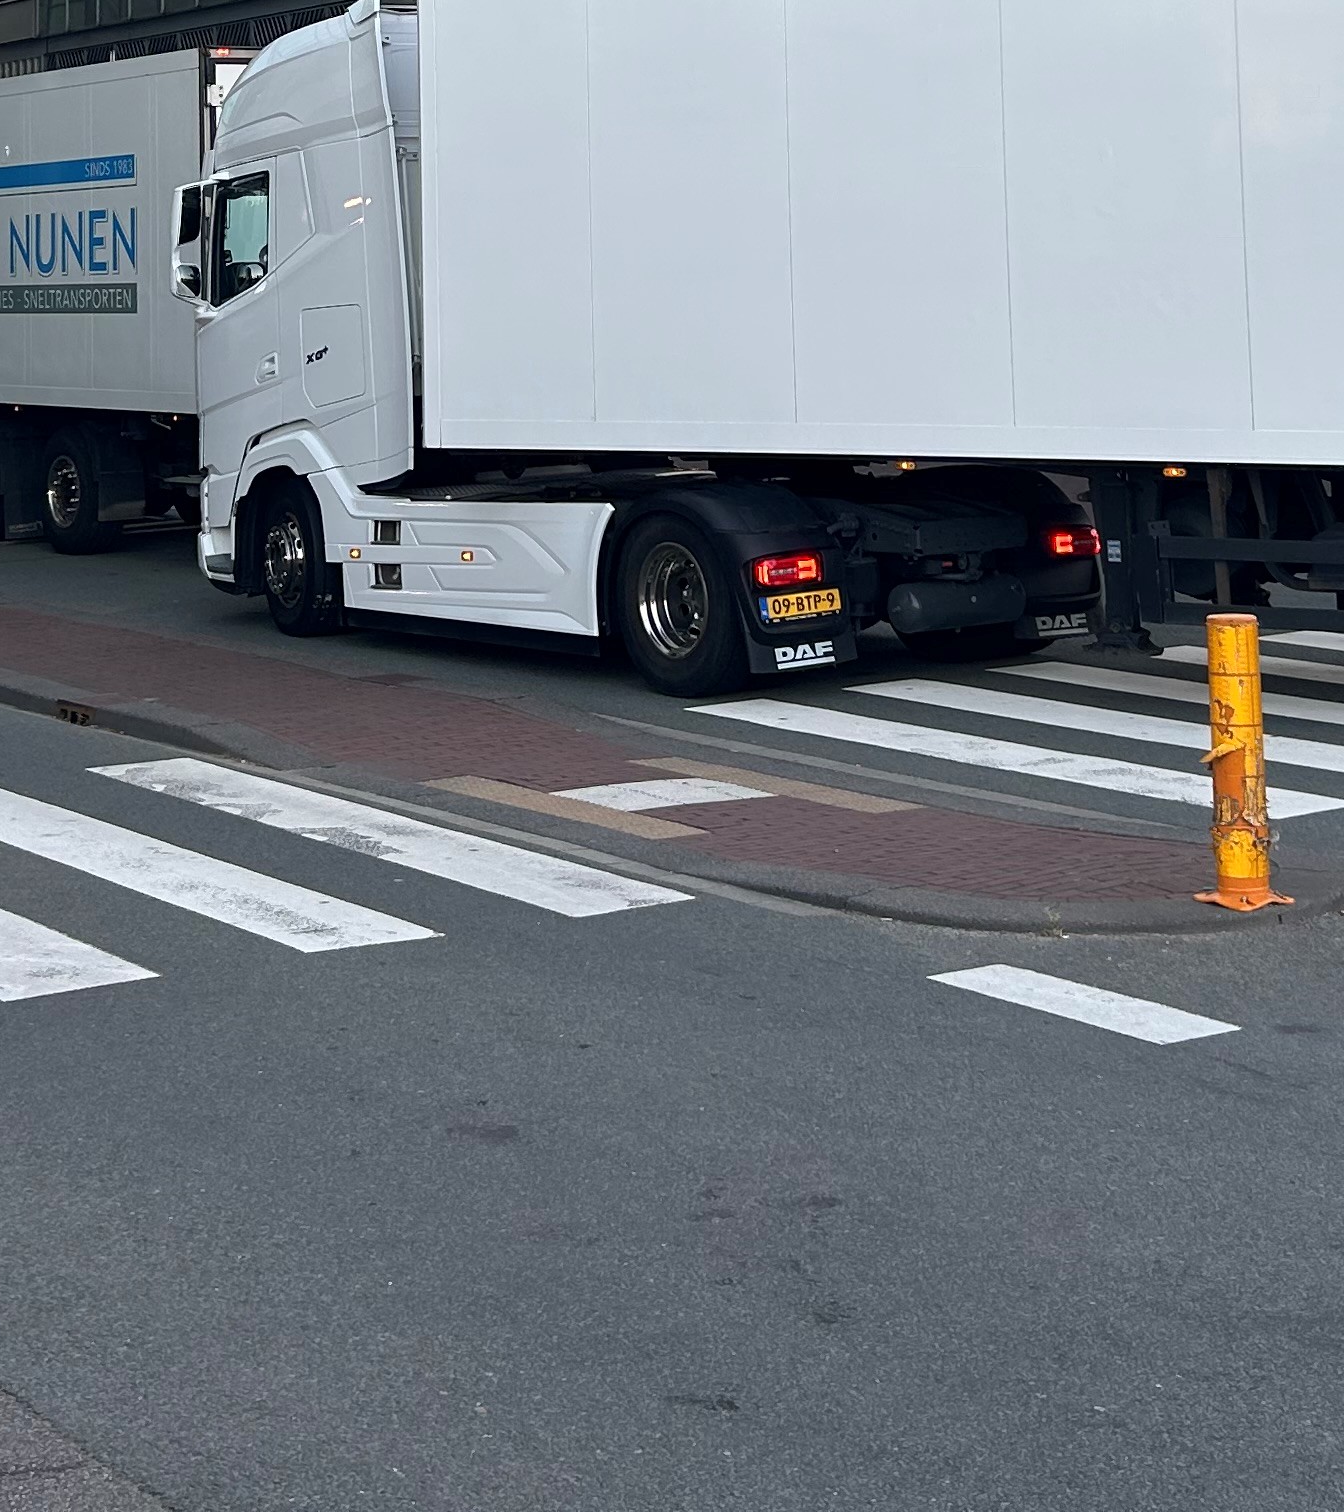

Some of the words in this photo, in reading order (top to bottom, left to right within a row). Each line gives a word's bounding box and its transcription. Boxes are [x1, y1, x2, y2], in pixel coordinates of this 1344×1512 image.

[85, 161, 111, 178] SINDS
[113, 159, 133, 175] 1983
[10, 207, 138, 276] NUNEN
[24, 288, 133, 309] SNELTRANSPORTEN
[772, 592, 835, 615] 09-BTP-9
[1035, 612, 1087, 630] DAF
[774, 640, 834, 662] DAF
